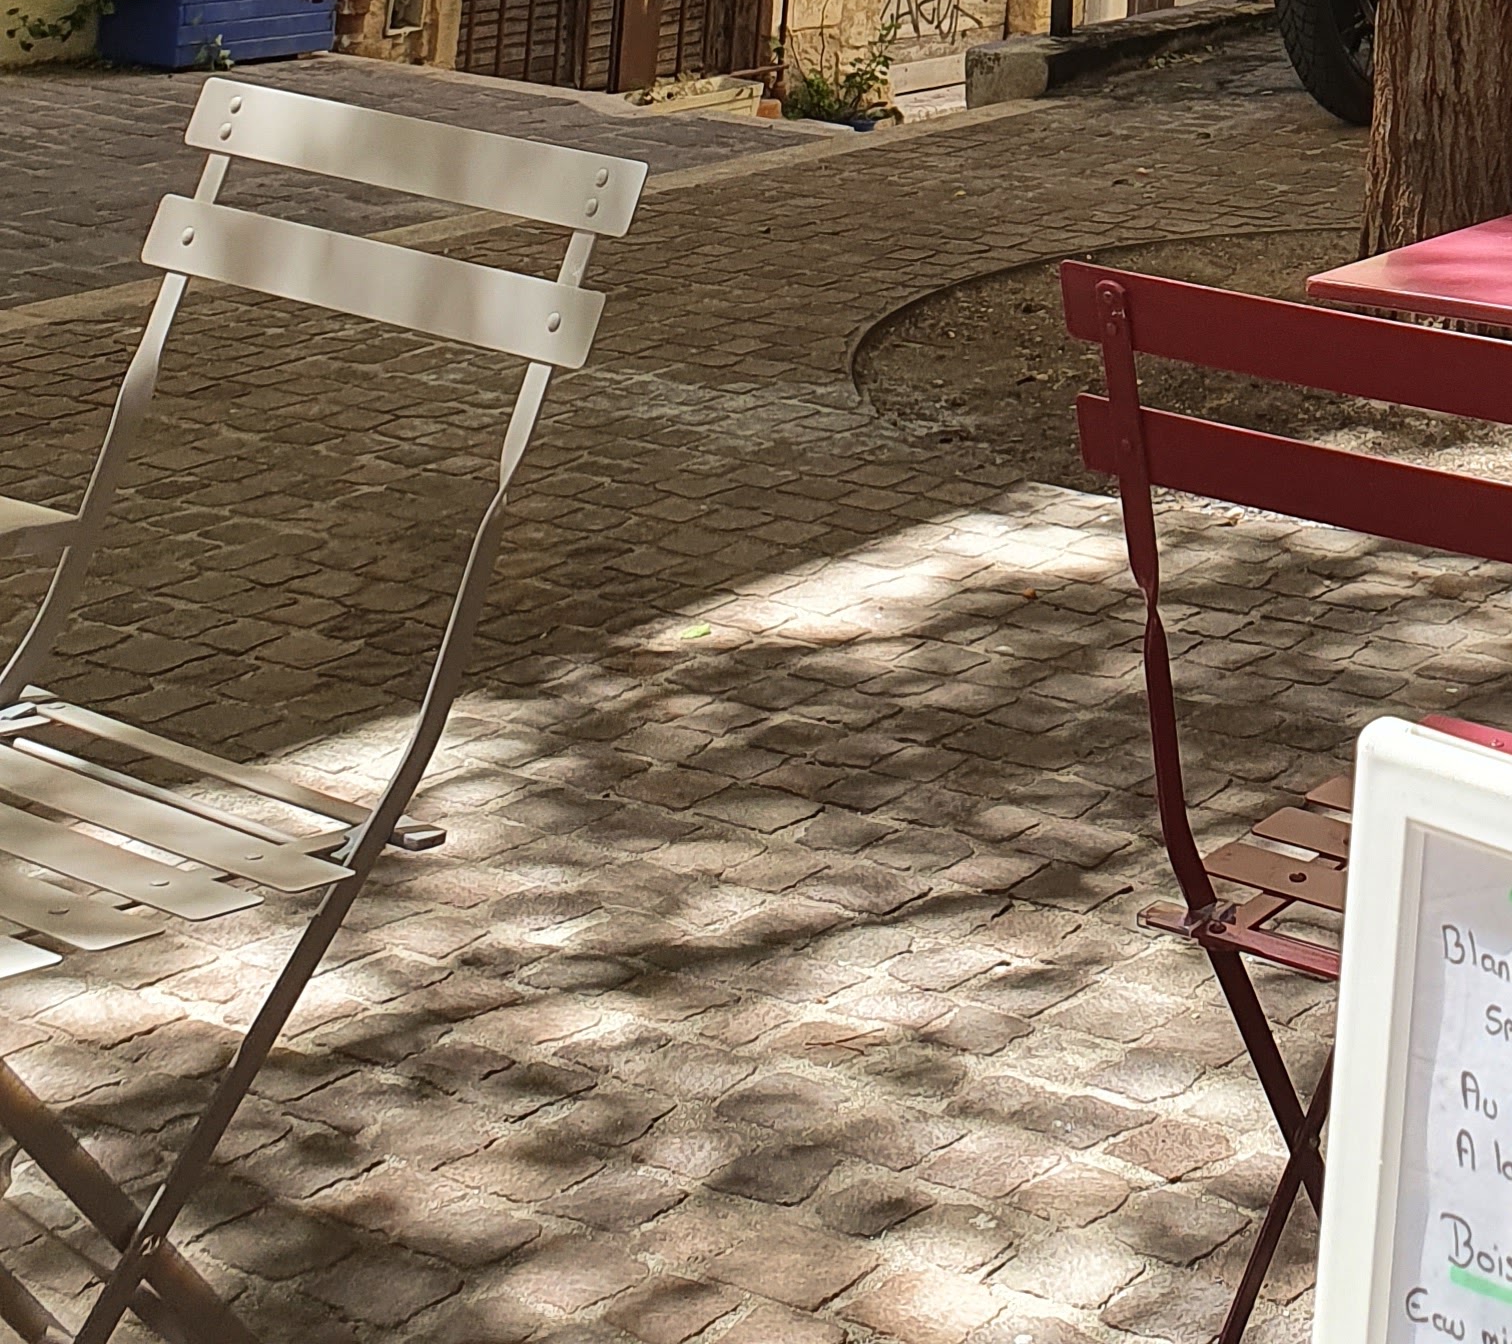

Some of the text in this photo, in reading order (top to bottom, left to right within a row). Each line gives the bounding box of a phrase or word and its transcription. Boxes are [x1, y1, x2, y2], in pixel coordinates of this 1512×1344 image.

[1461, 1071, 1498, 1119] Au
[1456, 1129, 1476, 1172] A
[1404, 1287, 1466, 1341] Eau
